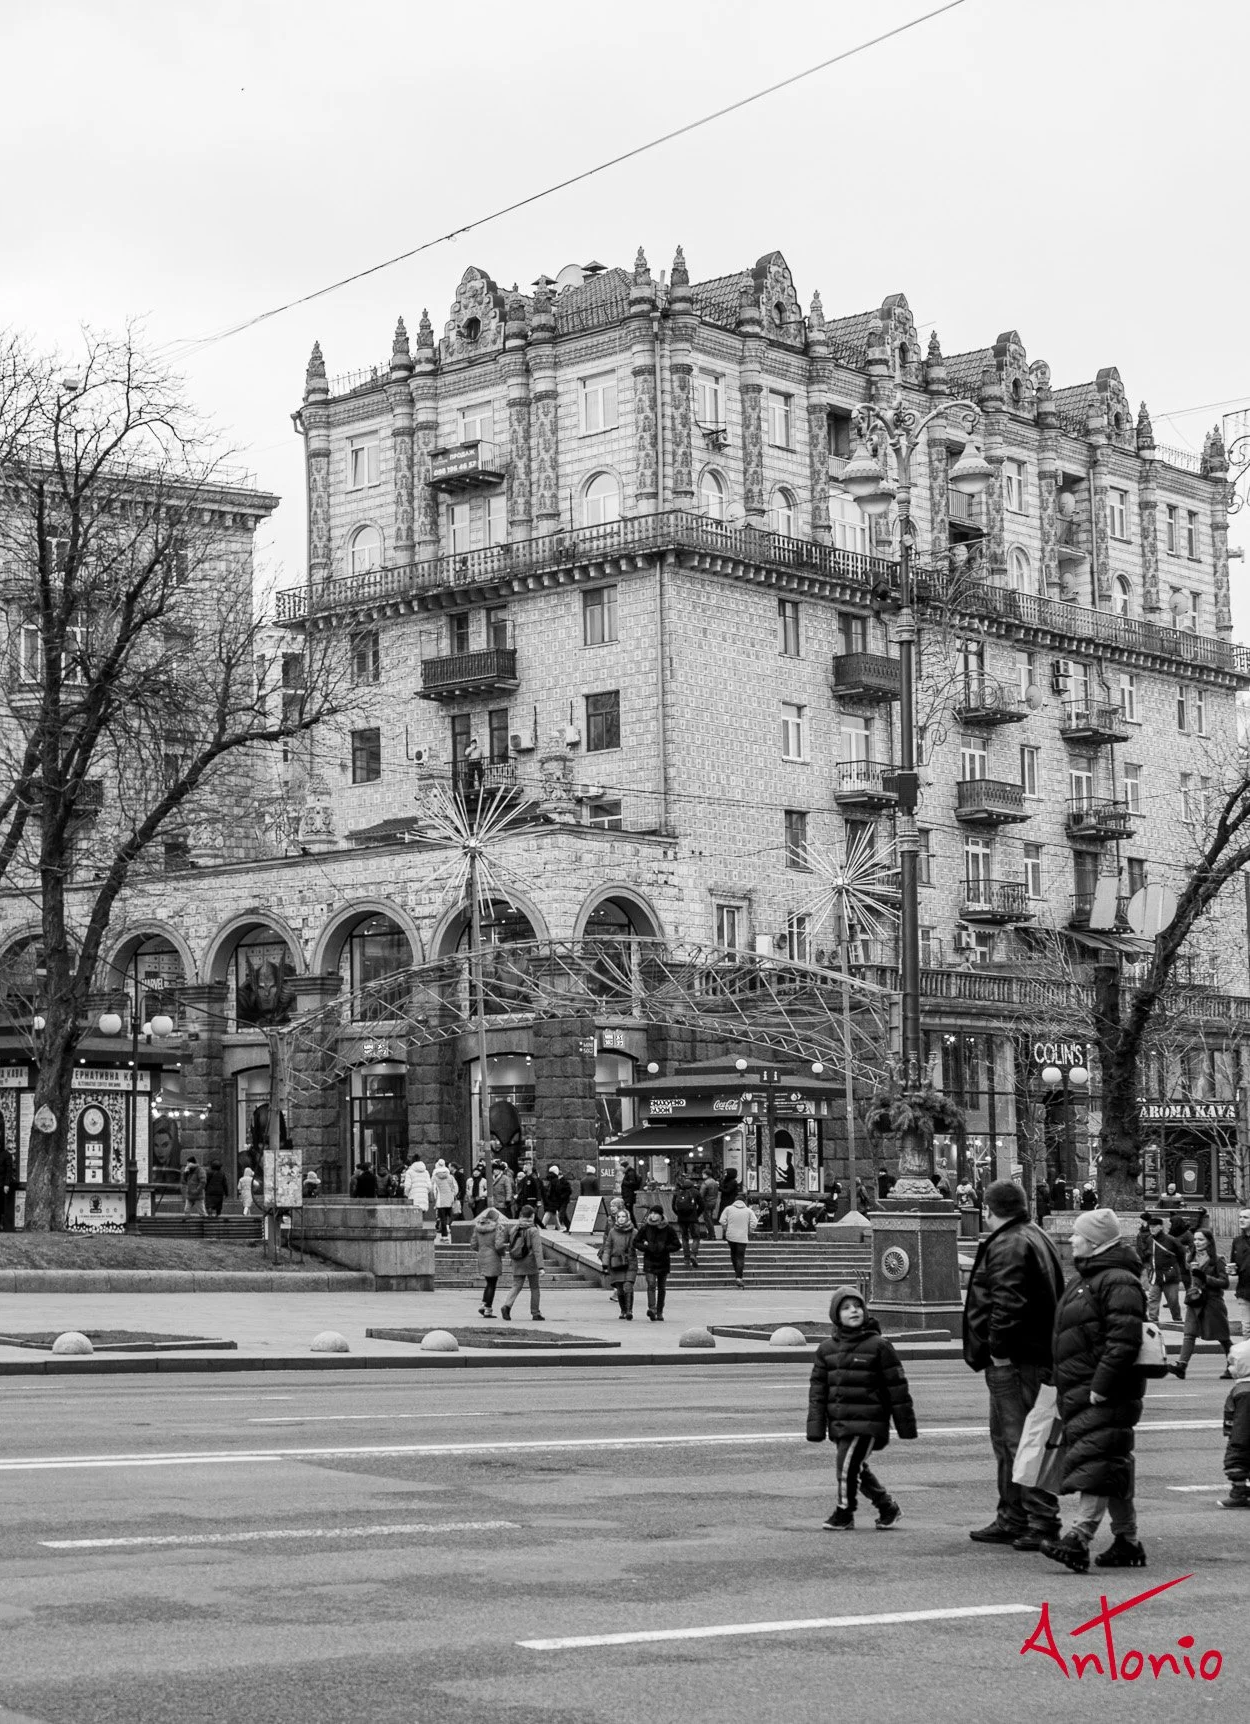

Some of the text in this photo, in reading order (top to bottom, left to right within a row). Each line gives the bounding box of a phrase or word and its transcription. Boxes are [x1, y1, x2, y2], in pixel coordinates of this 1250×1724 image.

[1034, 1043, 1083, 1066] COLIN'S
[75, 1070, 144, 1082] ЕРНАТИВНА КАА
[1139, 1105, 1235, 1118] AROMA KAVA
[600, 1168, 615, 1177] SALE
